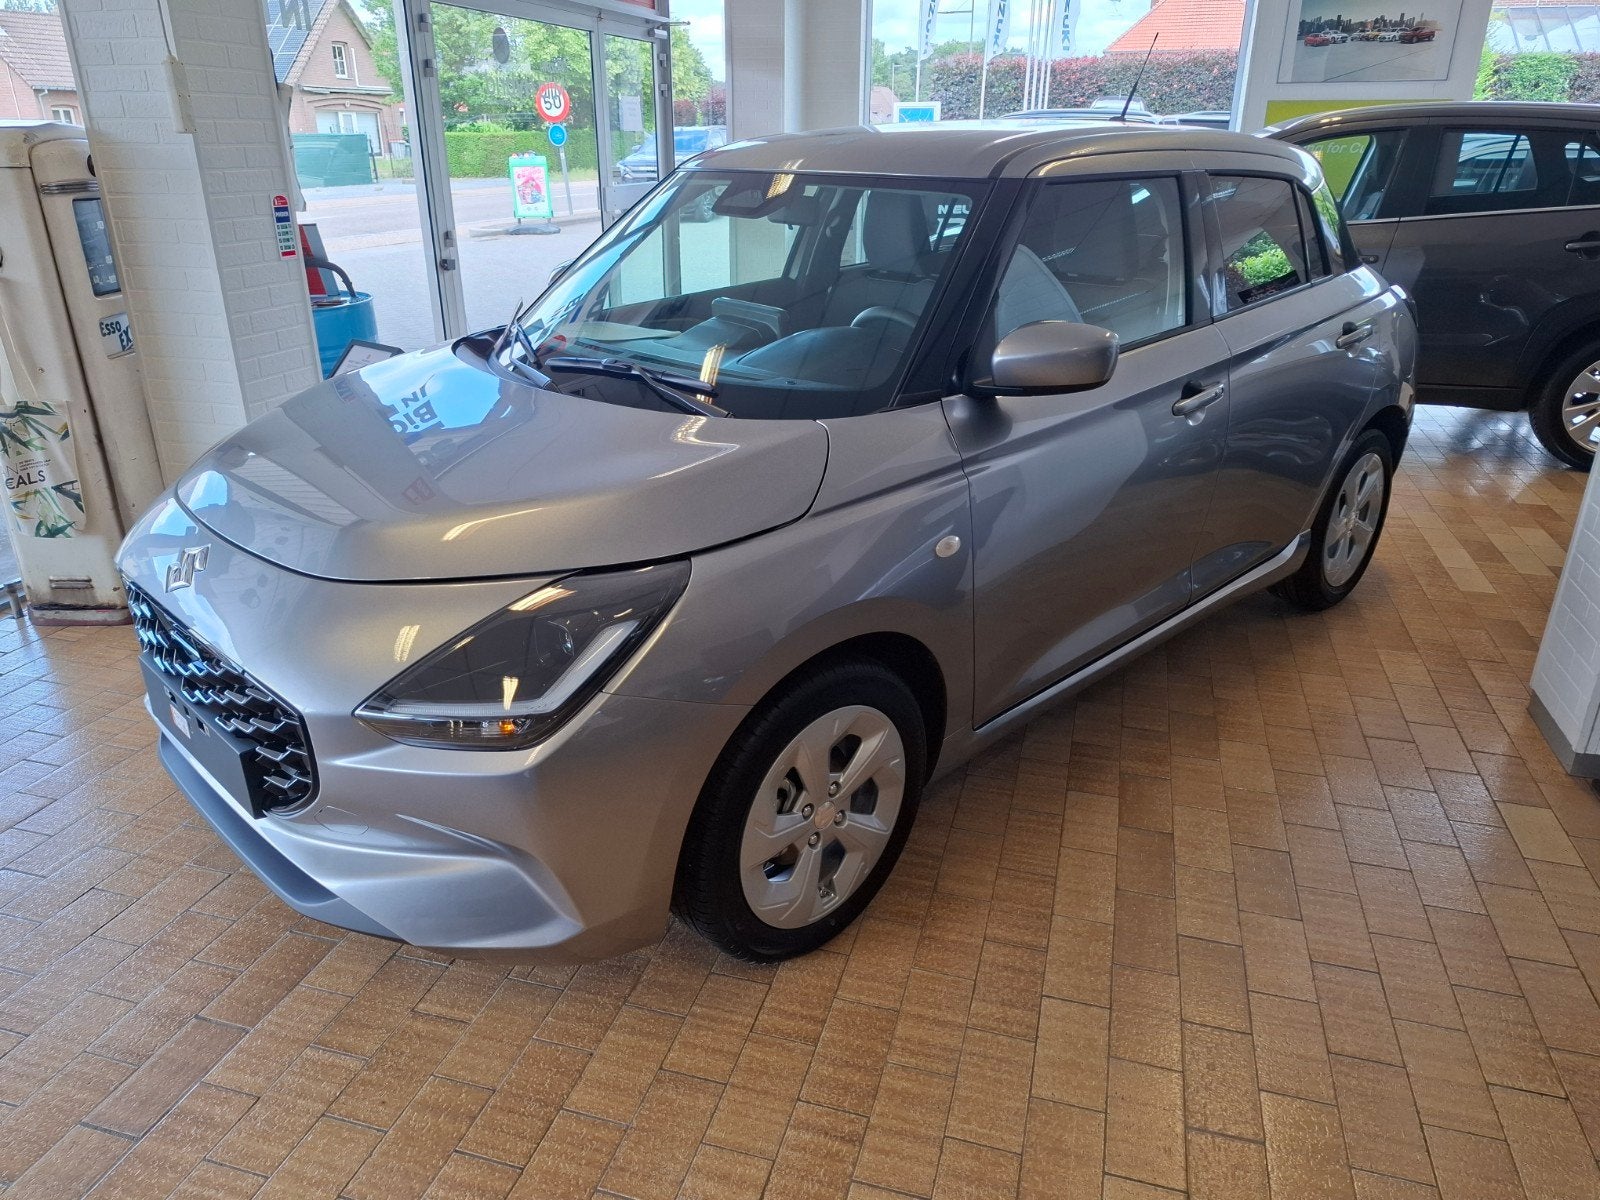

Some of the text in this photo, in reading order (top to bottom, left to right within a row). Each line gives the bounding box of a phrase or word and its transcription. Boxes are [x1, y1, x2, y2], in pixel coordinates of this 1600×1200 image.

[992, 0, 1007, 55] ZUKI
[543, 93, 562, 111] 50
[1326, 142, 1347, 154] for
[99, 320, 121, 338] ESSO
